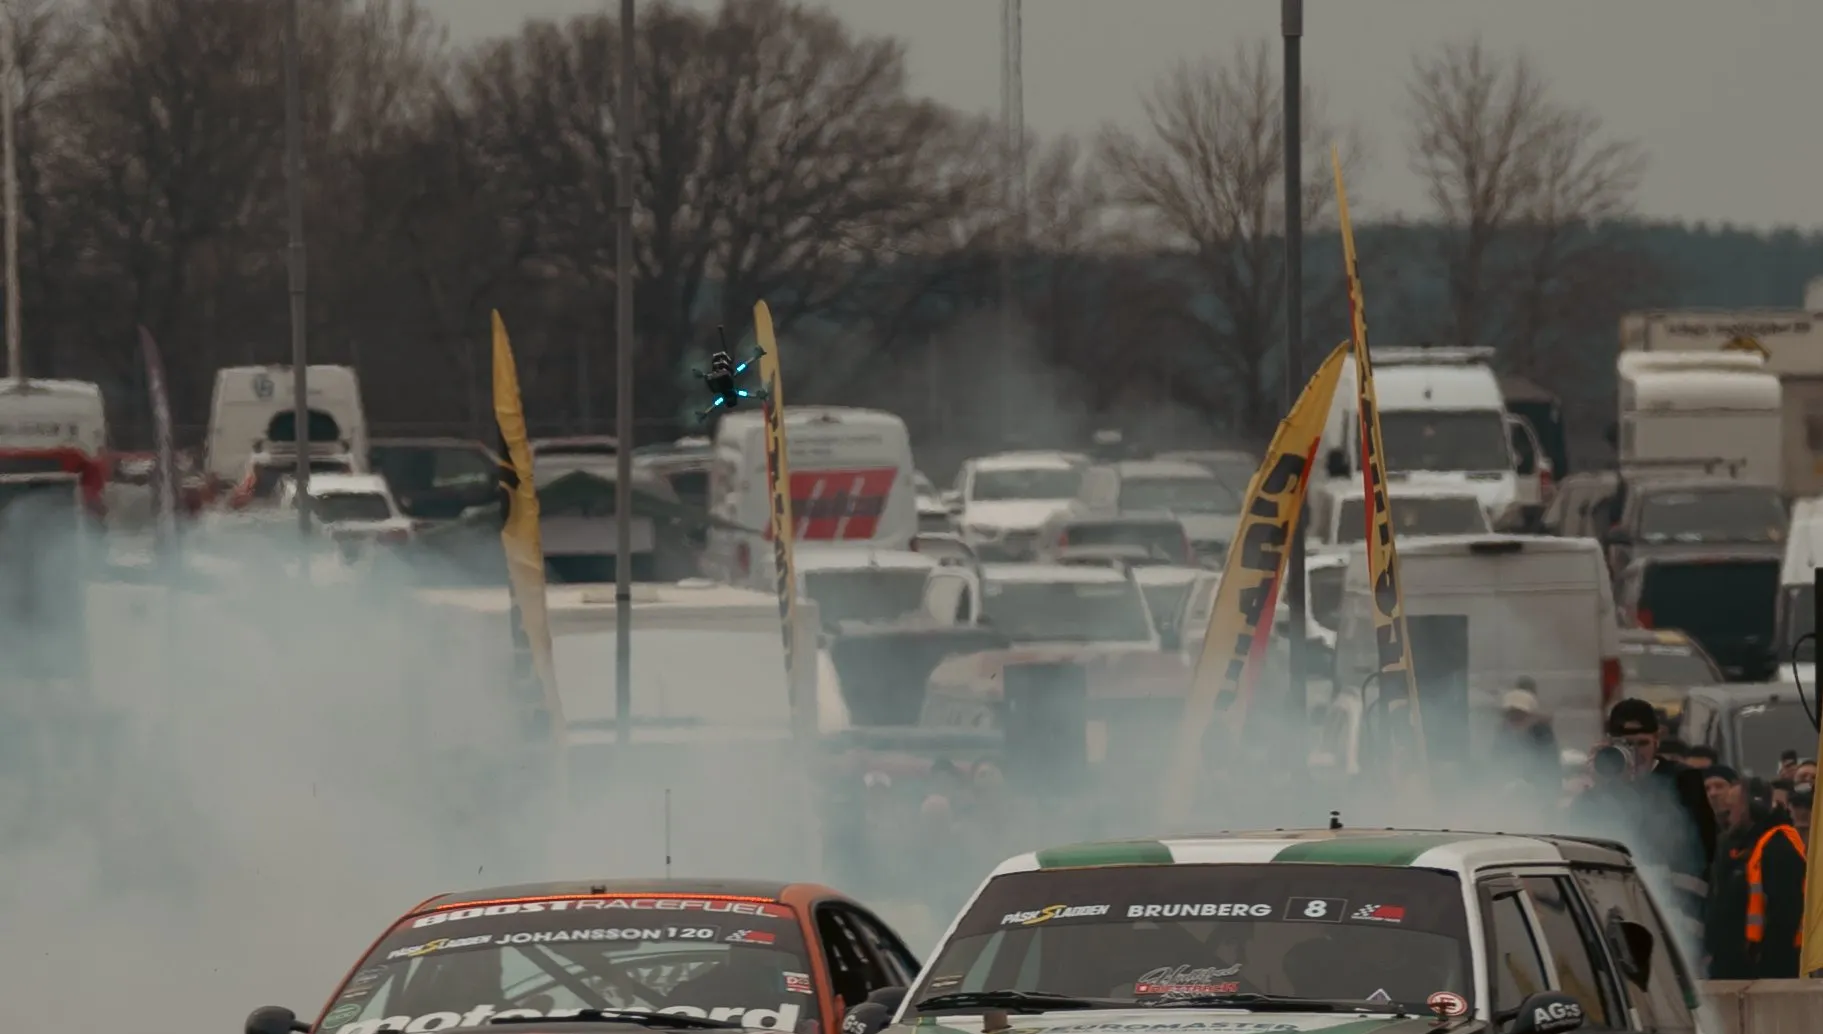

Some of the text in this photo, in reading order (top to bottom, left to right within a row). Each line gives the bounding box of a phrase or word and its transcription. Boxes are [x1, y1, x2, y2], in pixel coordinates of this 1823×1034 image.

[1127, 903, 1273, 918] BRUNBERG
[1303, 899, 1328, 917] 8
[494, 926, 662, 945] JOHANSSON
[667, 926, 714, 939] 120
[1051, 1022, 1300, 1032] EUROMASTER
